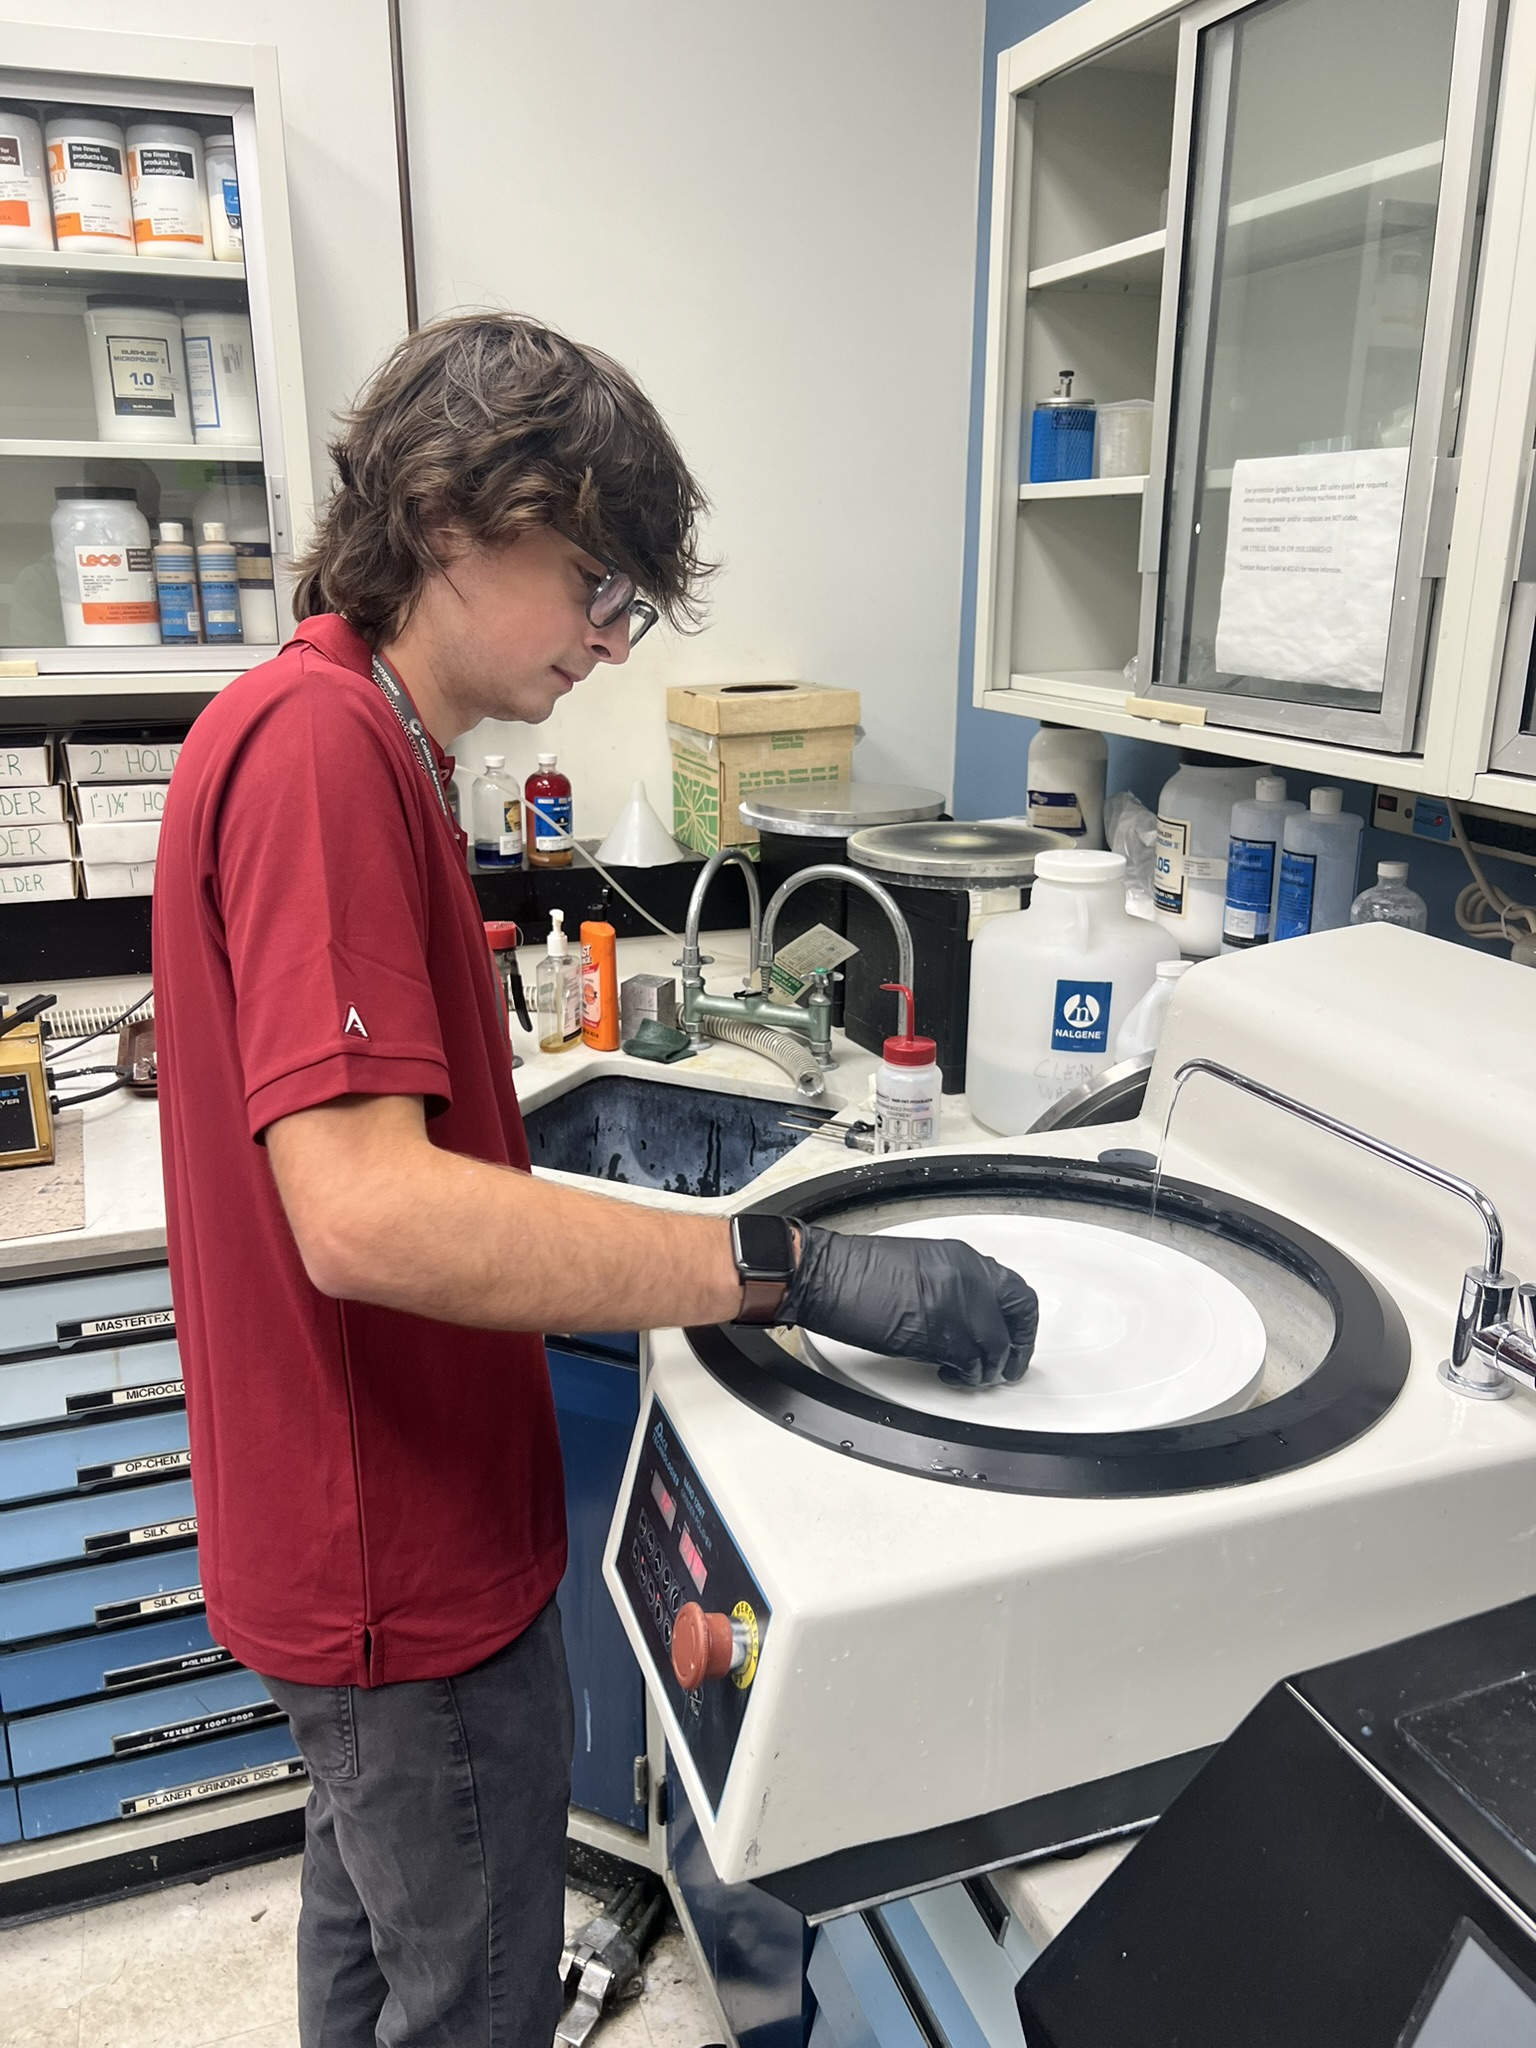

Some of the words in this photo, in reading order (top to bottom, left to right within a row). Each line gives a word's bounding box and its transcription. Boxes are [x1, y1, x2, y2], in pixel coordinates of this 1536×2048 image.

[74, 162, 115, 172] metallography
[145, 168, 185, 176] metallography
[129, 372, 154, 386] 1.0
[1366, 481, 1388, 489] required
[79, 554, 122, 567] LECO
[90, 750, 110, 775] 2"
[420, 738, 434, 769] Collins
[431, 770, 448, 816] Aerospace
[1055, 1029, 1101, 1040] NALGENE
[1034, 1059, 1093, 1081] CLEAN
[96, 1313, 171, 1332] MASTERTEX
[126, 1455, 180, 1472] OP-CHEM
[143, 1526, 168, 1539] SILK
[154, 1596, 178, 1608] SILK
[182, 1654, 223, 1668] POLIMET
[162, 1725, 200, 1738] TEXMET
[204, 1712, 254, 1729] 1000/2000
[148, 1790, 192, 1807] PLANER
[198, 1776, 249, 1794] GRINDING
[254, 1768, 279, 1781] DISC
